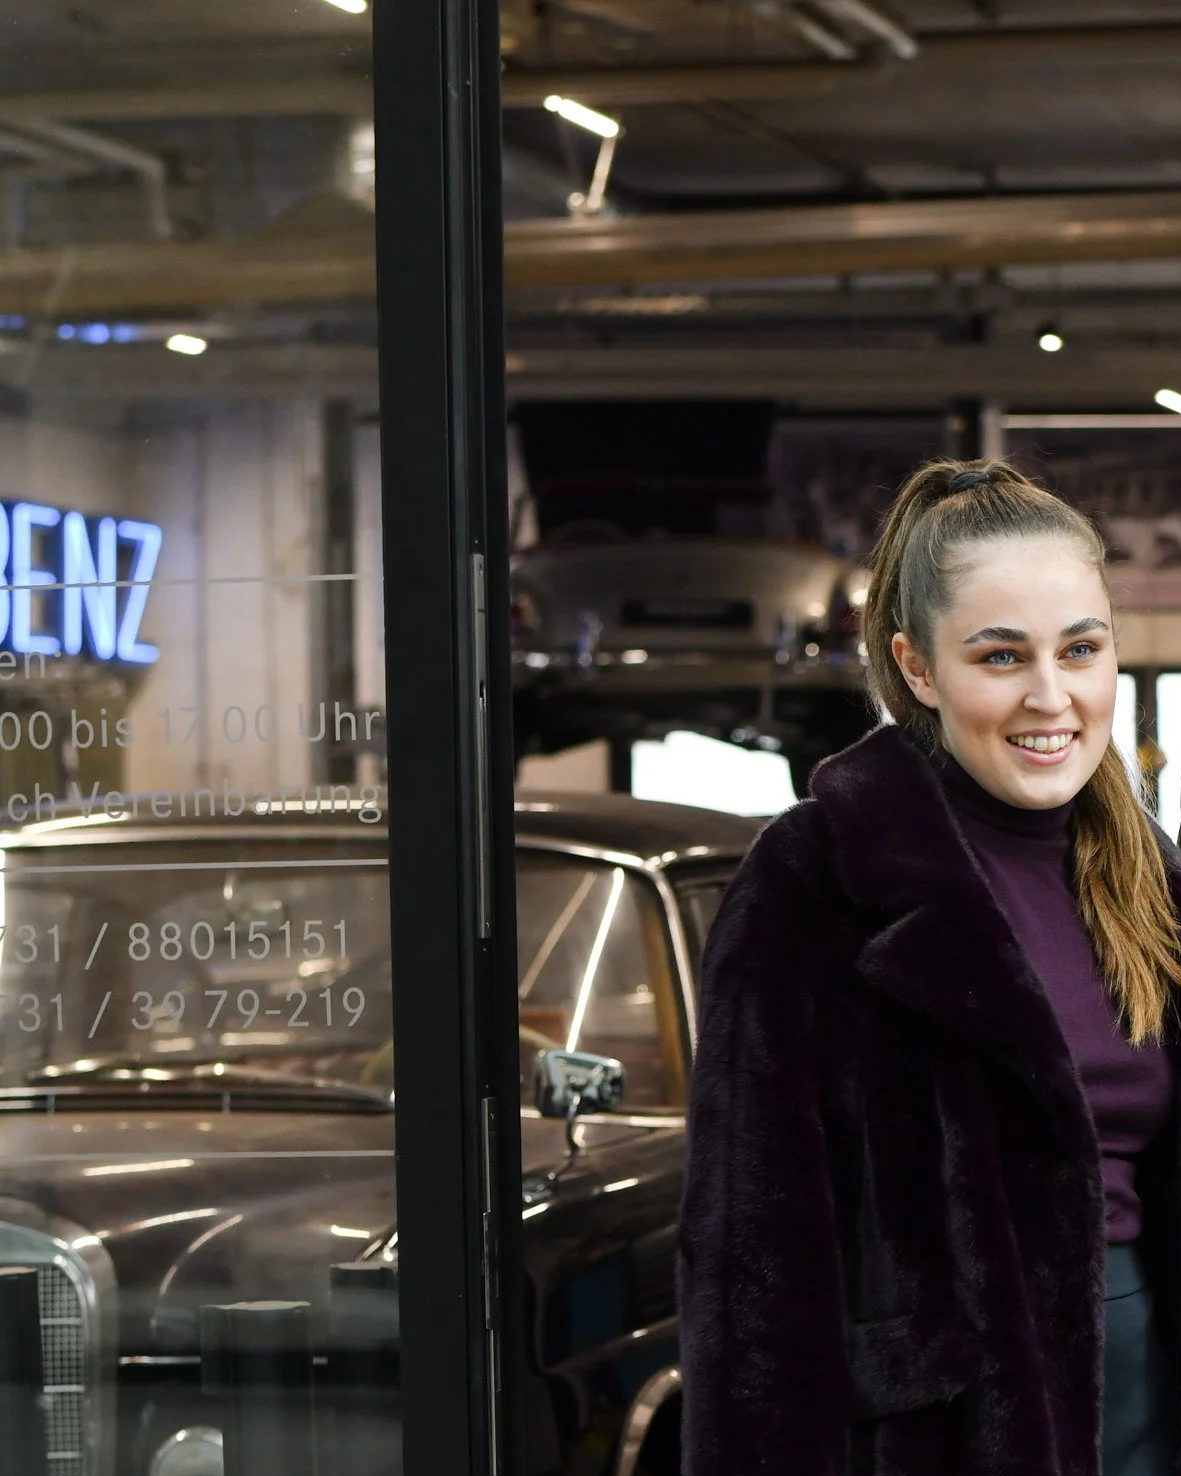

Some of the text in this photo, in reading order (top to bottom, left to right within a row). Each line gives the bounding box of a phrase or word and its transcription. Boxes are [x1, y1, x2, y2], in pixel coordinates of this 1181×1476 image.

[0, 502, 162, 663] ENZ
[71, 708, 134, 749] bis
[298, 701, 381, 743] Uhr
[7, 778, 382, 824] ch Vereinbarung
[0, 923, 60, 964] 31
[128, 919, 348, 961] 88015151
[131, 990, 186, 1030] 39
[204, 986, 366, 1029] 79-219
